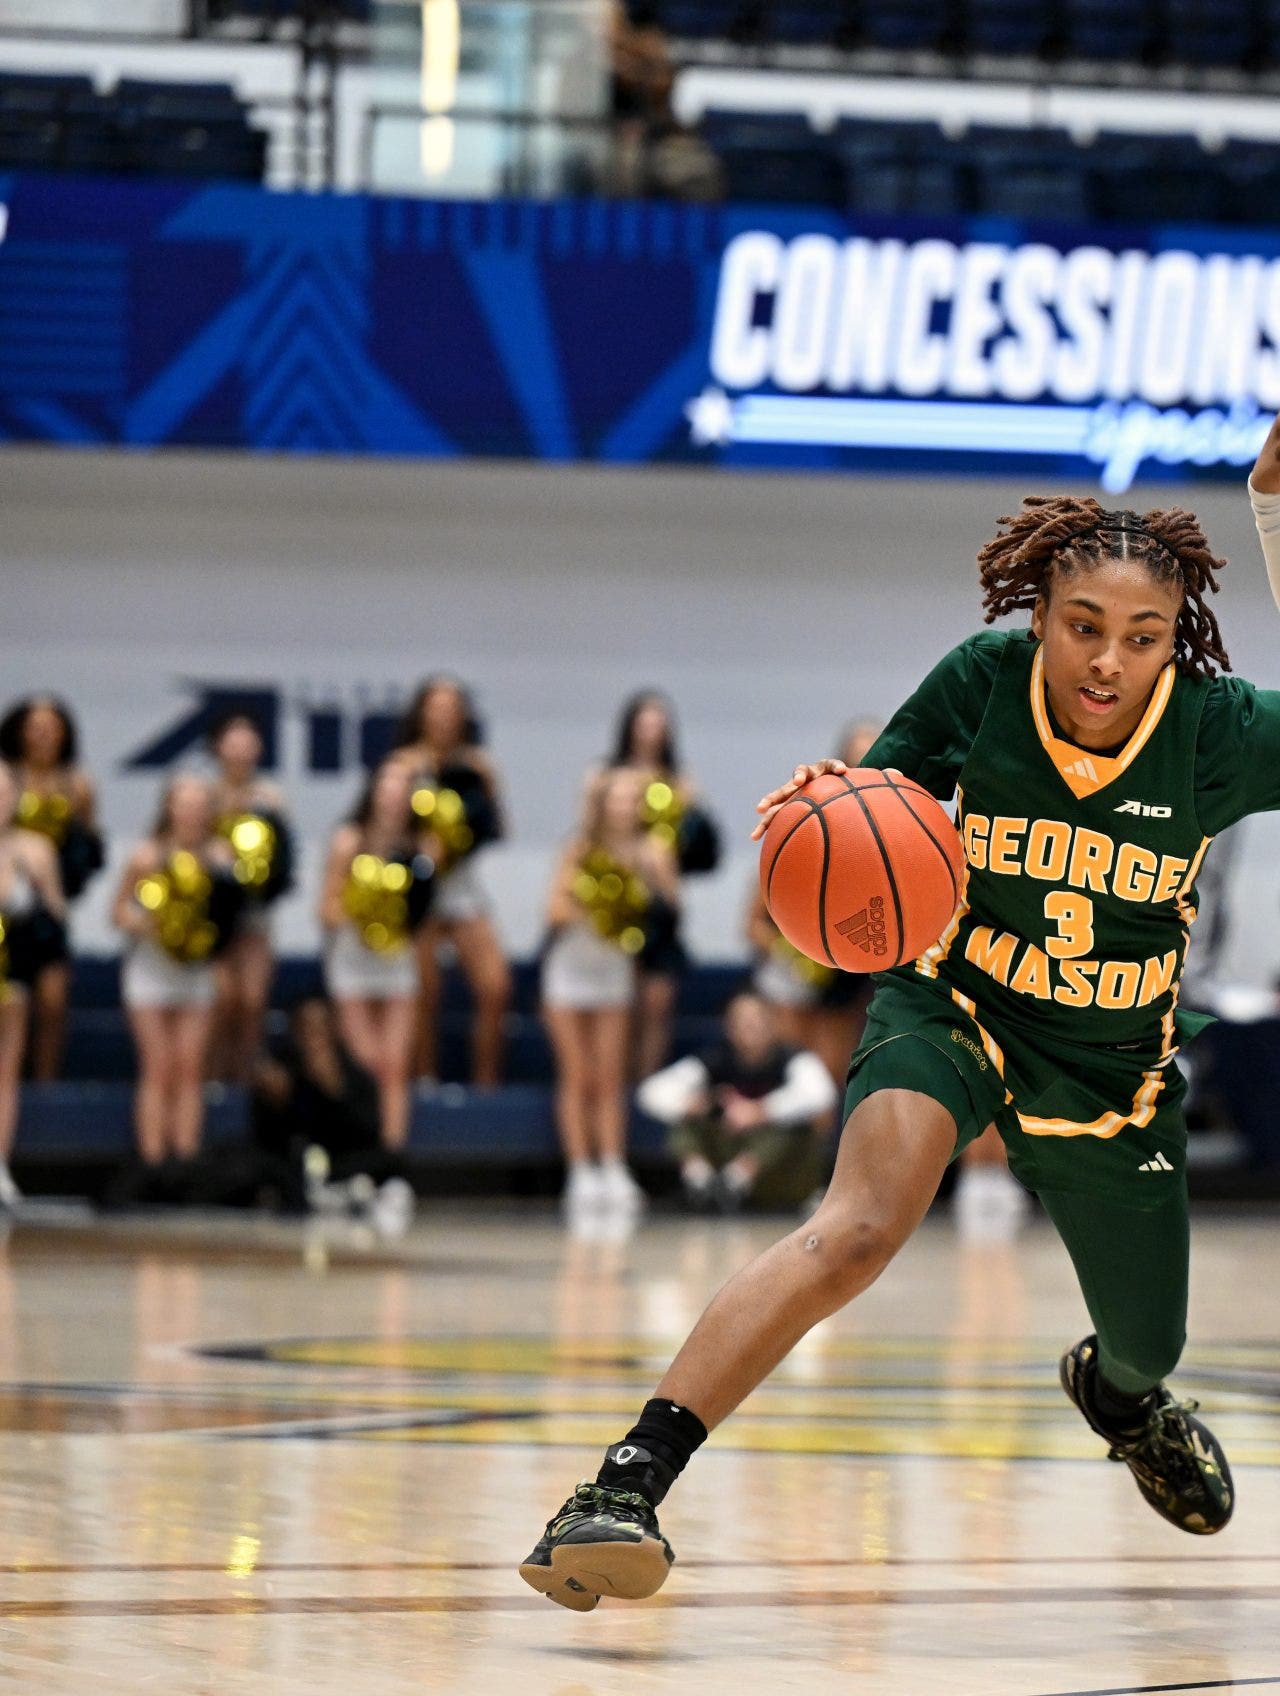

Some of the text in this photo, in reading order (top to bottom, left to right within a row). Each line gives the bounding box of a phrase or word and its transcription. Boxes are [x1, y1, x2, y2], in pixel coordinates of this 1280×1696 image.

[1113, 799, 1173, 819] A10
[963, 813, 1190, 904] GEORGE
[867, 895, 888, 957] adidas
[1043, 890, 1095, 960] 3
[964, 925, 1178, 1010] MASON
[950, 1028, 988, 1071] Patriots
